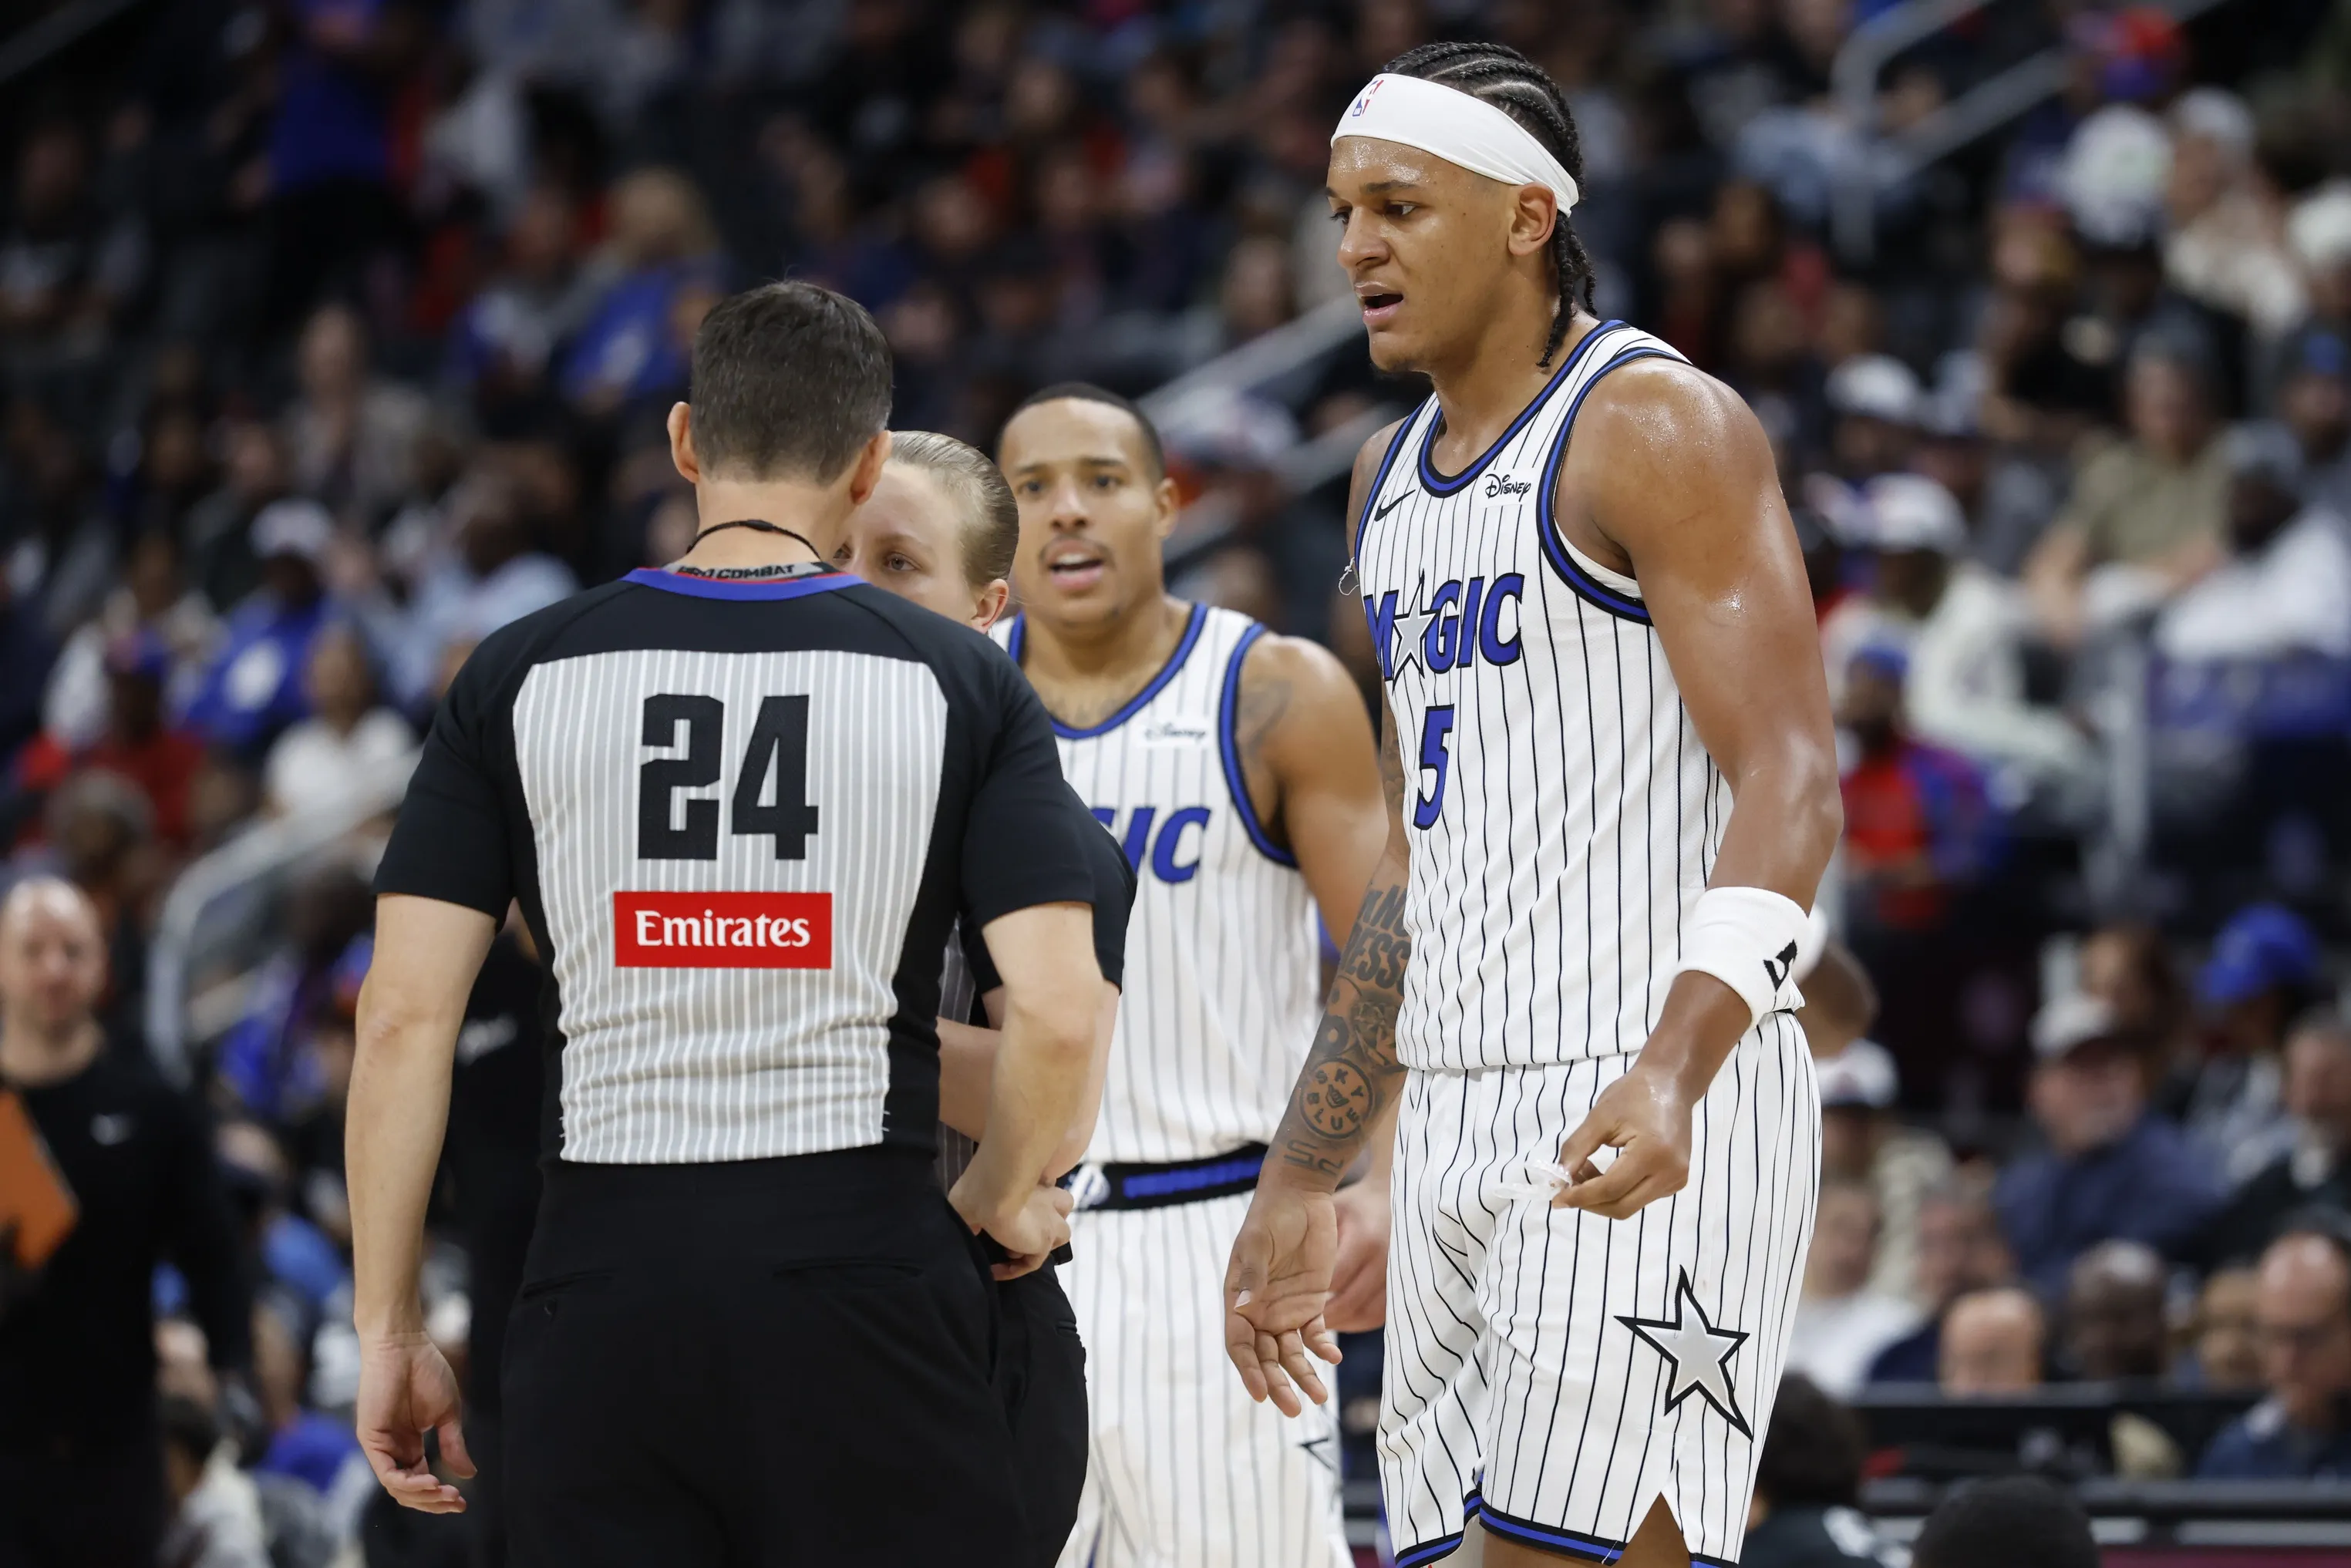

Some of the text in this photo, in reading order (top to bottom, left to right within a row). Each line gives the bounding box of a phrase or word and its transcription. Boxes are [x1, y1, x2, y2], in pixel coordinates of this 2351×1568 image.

[716, 564, 795, 579] COMBAT
[638, 694, 819, 860] 24
[1413, 703, 1455, 830] 5
[1091, 806, 1211, 884] IC
[635, 909, 811, 948] Emirates
